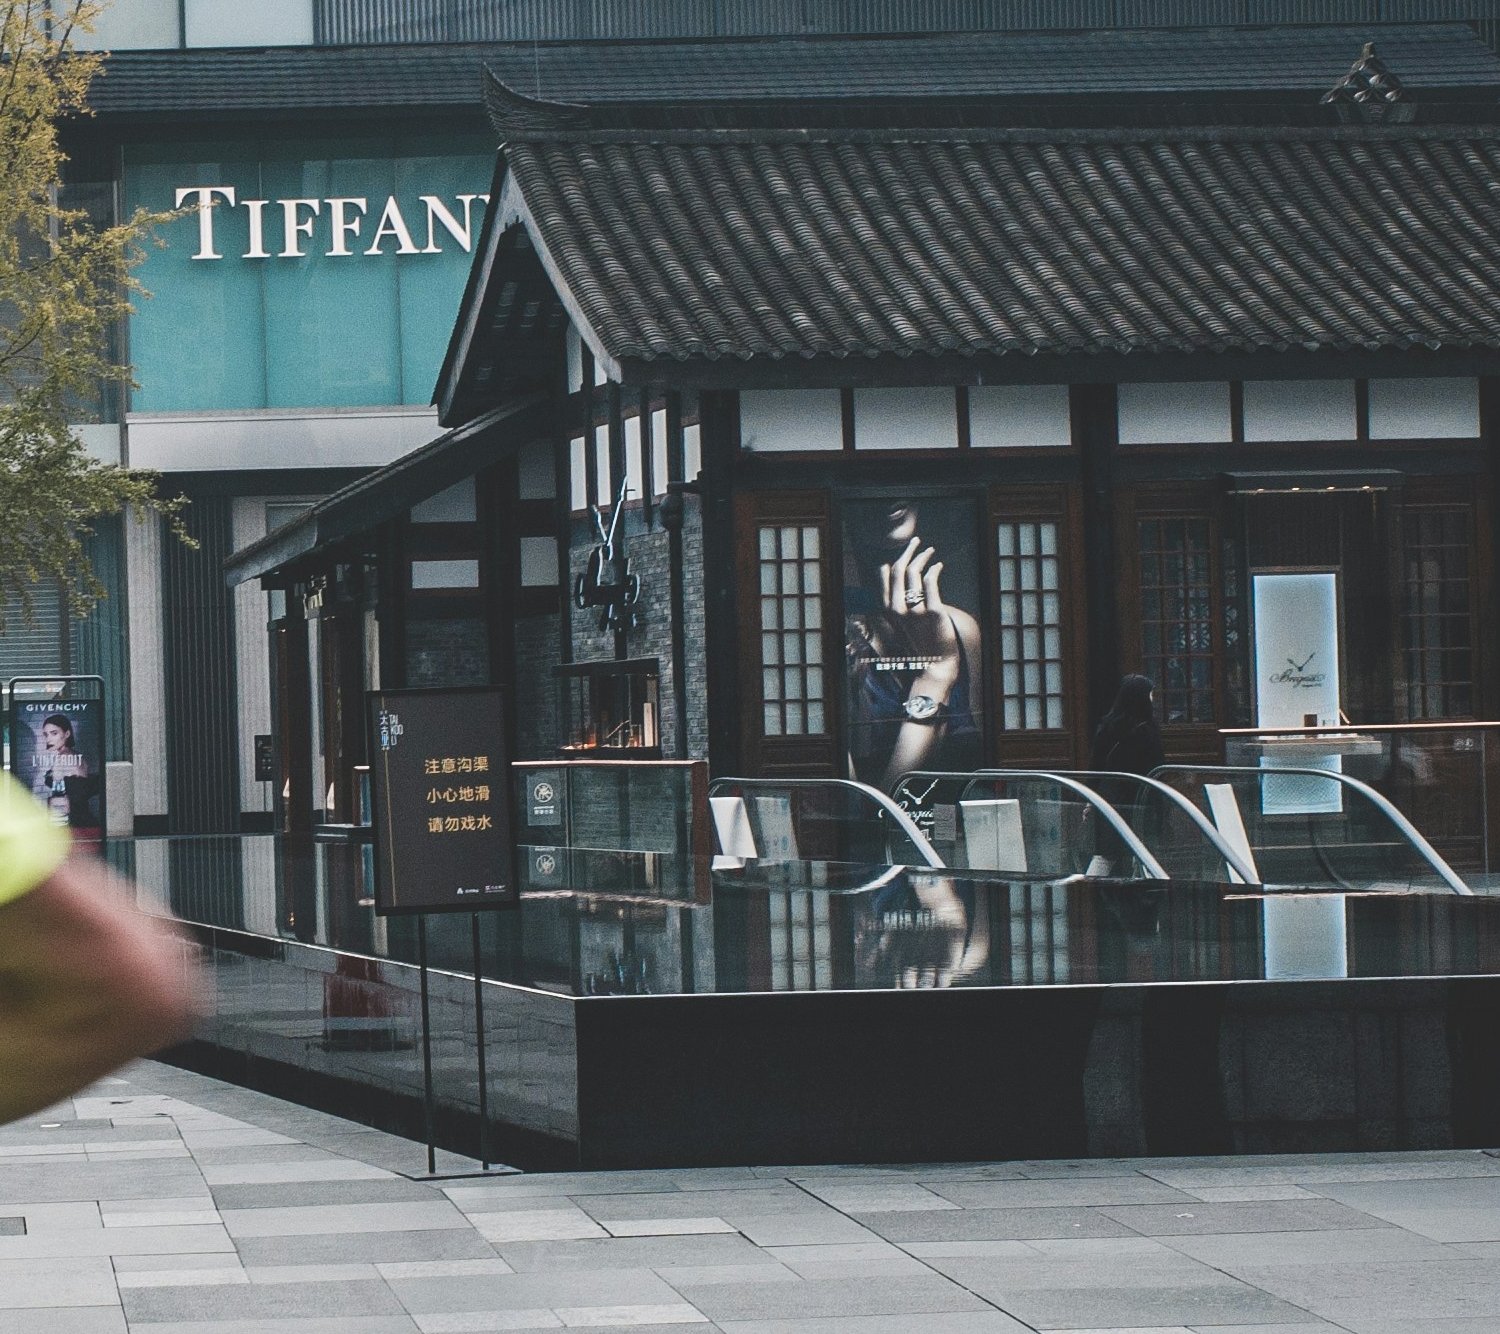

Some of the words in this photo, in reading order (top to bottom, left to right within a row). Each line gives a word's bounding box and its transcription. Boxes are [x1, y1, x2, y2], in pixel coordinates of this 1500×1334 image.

[174, 186, 491, 260] TIFFAN
[25, 703, 88, 712] GIVENCHY
[424, 755, 490, 775] 注意沟渠
[426, 785, 490, 804] 小心地滑
[427, 814, 493, 833] 请勿戏水
